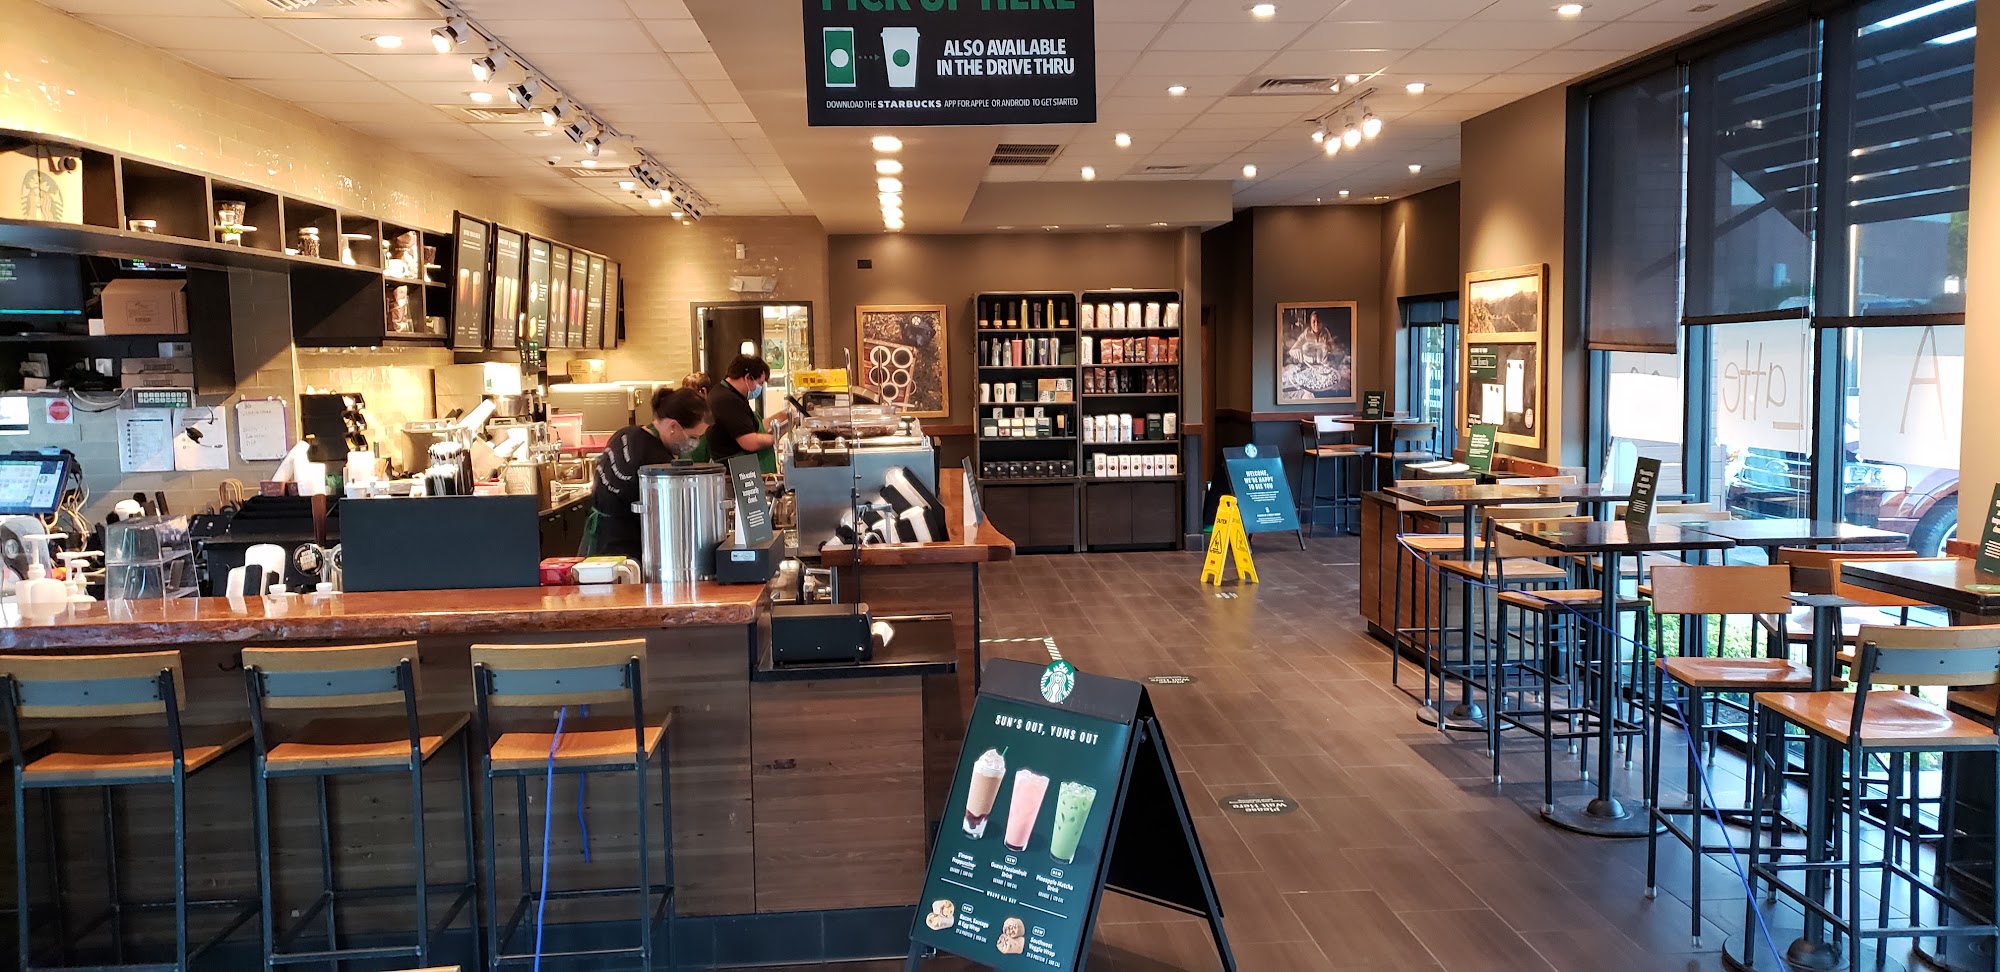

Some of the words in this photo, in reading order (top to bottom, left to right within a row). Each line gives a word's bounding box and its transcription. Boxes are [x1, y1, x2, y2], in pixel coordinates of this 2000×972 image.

[943, 39, 984, 56] ALSO
[986, 38, 1066, 55] AVAILABLE
[937, 60, 953, 75] IN
[955, 59, 983, 75] THE
[987, 59, 1032, 75] DRIVE
[1033, 58, 1074, 75] THRU
[826, 100, 864, 109] DOWNLOAD
[864, 100, 876, 108] THE
[877, 100, 942, 108] STARBUCKS
[957, 99, 970, 107] FOR
[970, 99, 989, 107] APPLE
[1001, 98, 1030, 106] ANDROID
[1032, 98, 1040, 106] TO
[1041, 98, 1053, 106] GET
[1052, 97, 1079, 106] STARTED
[995, 714, 1022, 730] SUN'S
[1025, 720, 1045, 736] OUT,
[1050, 725, 1076, 741] YUMS
[1079, 731, 1099, 745] OUT
